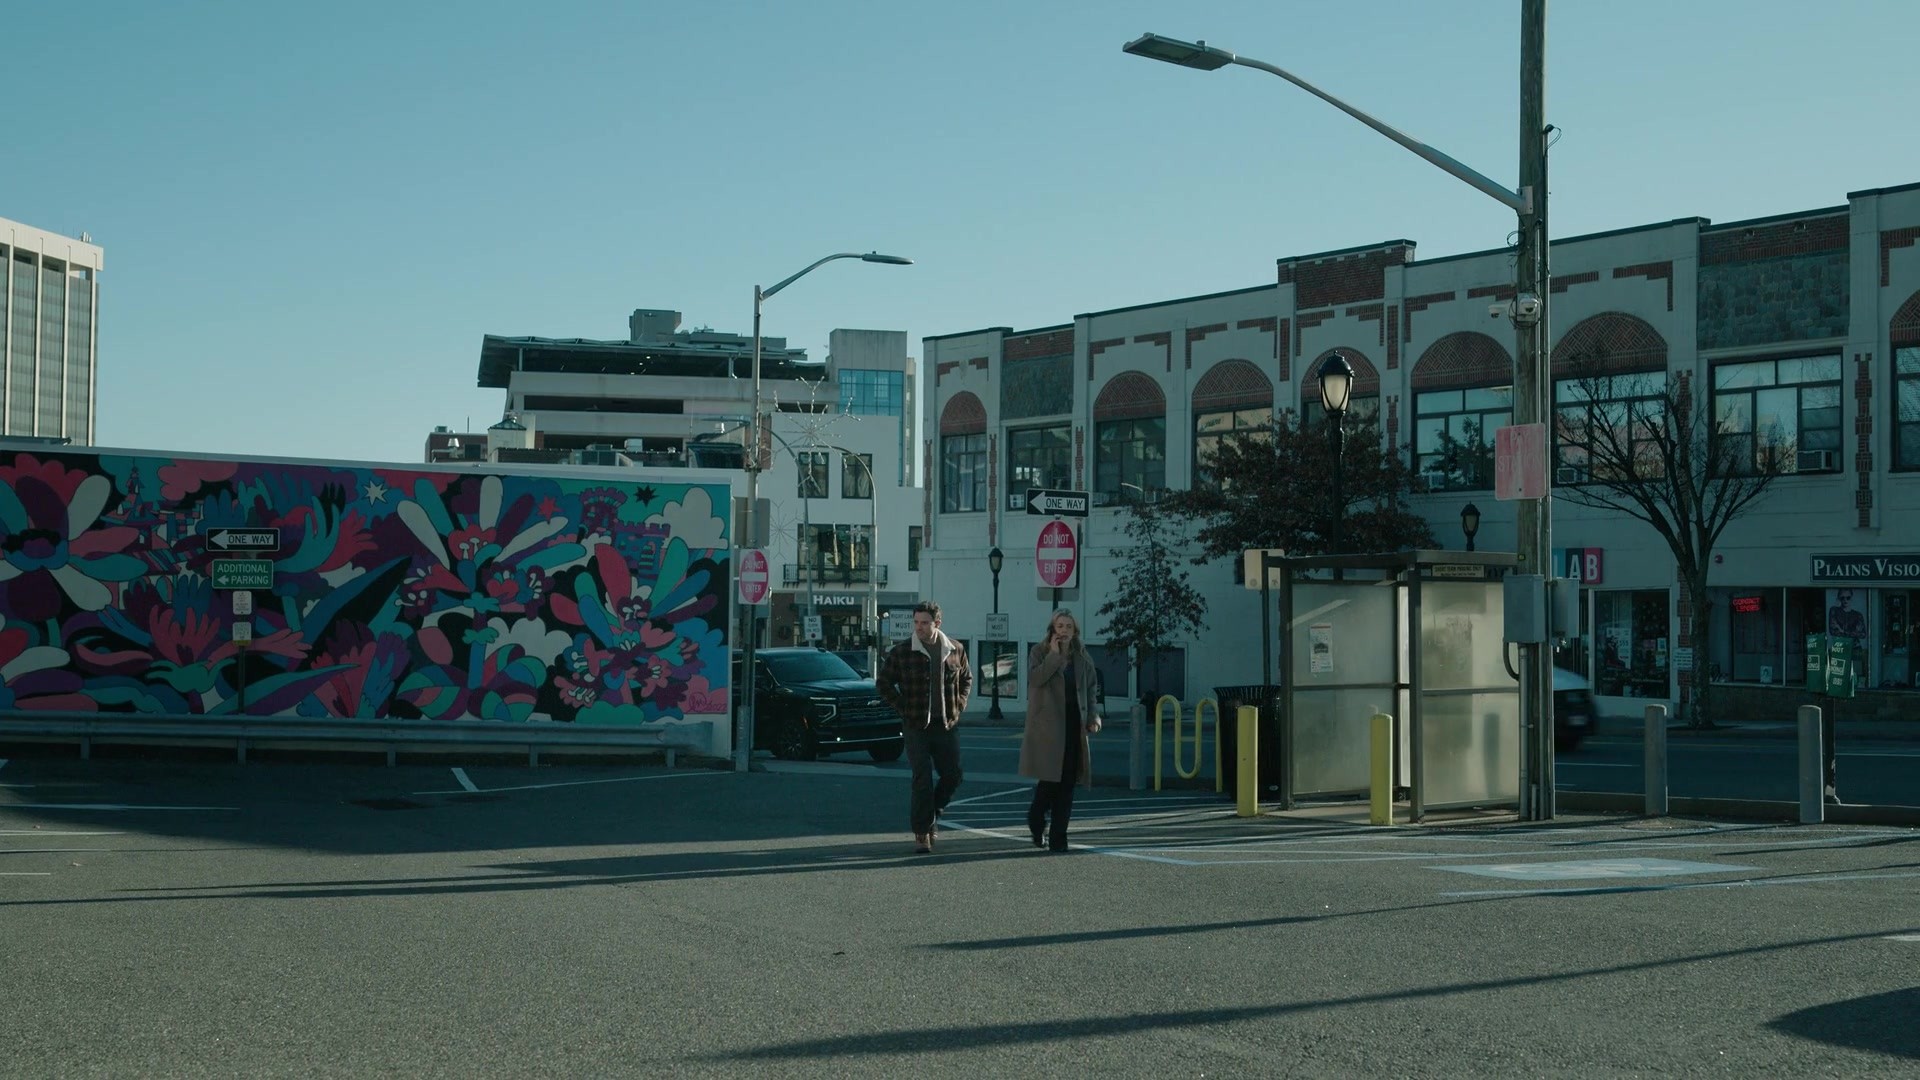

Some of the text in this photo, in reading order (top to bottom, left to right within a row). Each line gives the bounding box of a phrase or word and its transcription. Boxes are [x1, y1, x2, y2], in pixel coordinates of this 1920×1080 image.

[1046, 498, 1083, 509] ONE WAY
[228, 535, 271, 543] ONE WAY
[1043, 534, 1069, 544] DO NOT
[217, 564, 268, 573] ADDITIONAL
[1044, 563, 1066, 573] ENTER
[1813, 559, 1920, 576] PLAINS VISIO
[231, 576, 268, 584] PARKING
[813, 595, 854, 605] HAIKU
